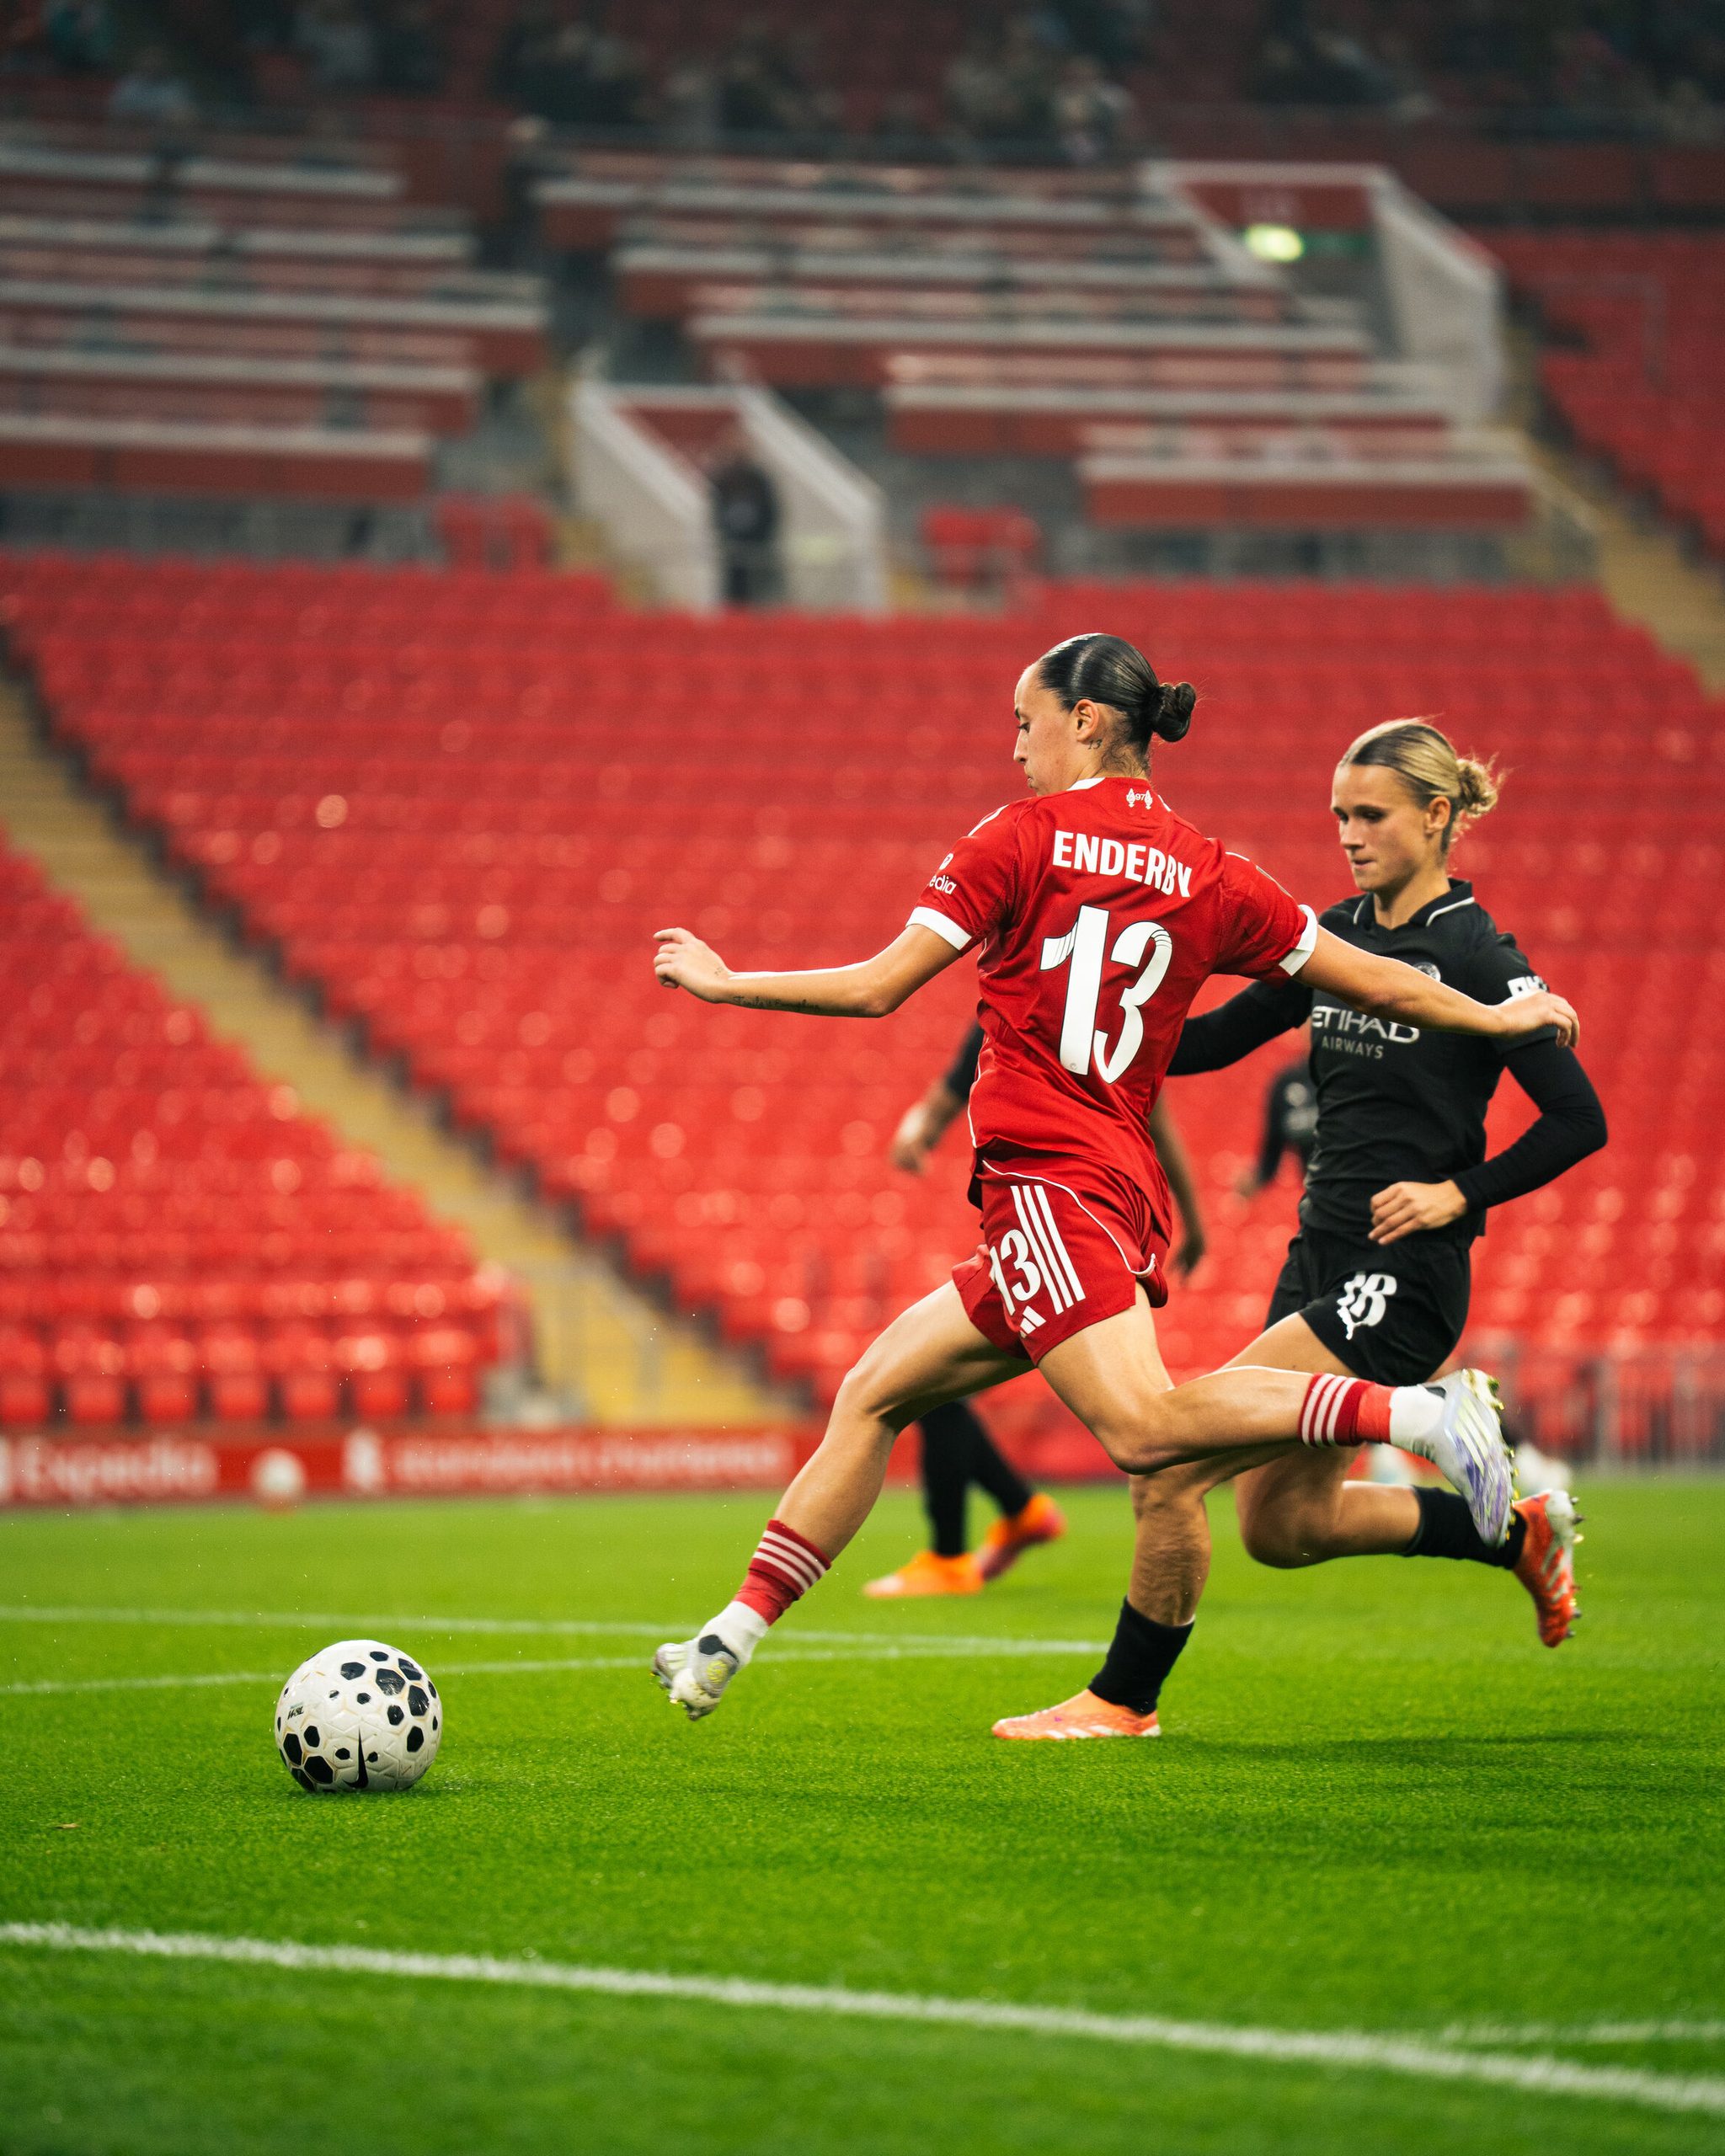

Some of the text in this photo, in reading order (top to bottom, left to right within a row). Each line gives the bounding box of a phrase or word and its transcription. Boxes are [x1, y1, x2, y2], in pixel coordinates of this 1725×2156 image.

[1052, 830, 1193, 898] ENDERBY
[1039, 905, 1173, 1085] 13
[1311, 1006, 1420, 1043] ETIHAD
[1322, 1035, 1384, 1059] AIRWAYS
[989, 1229, 1041, 1315] 13
